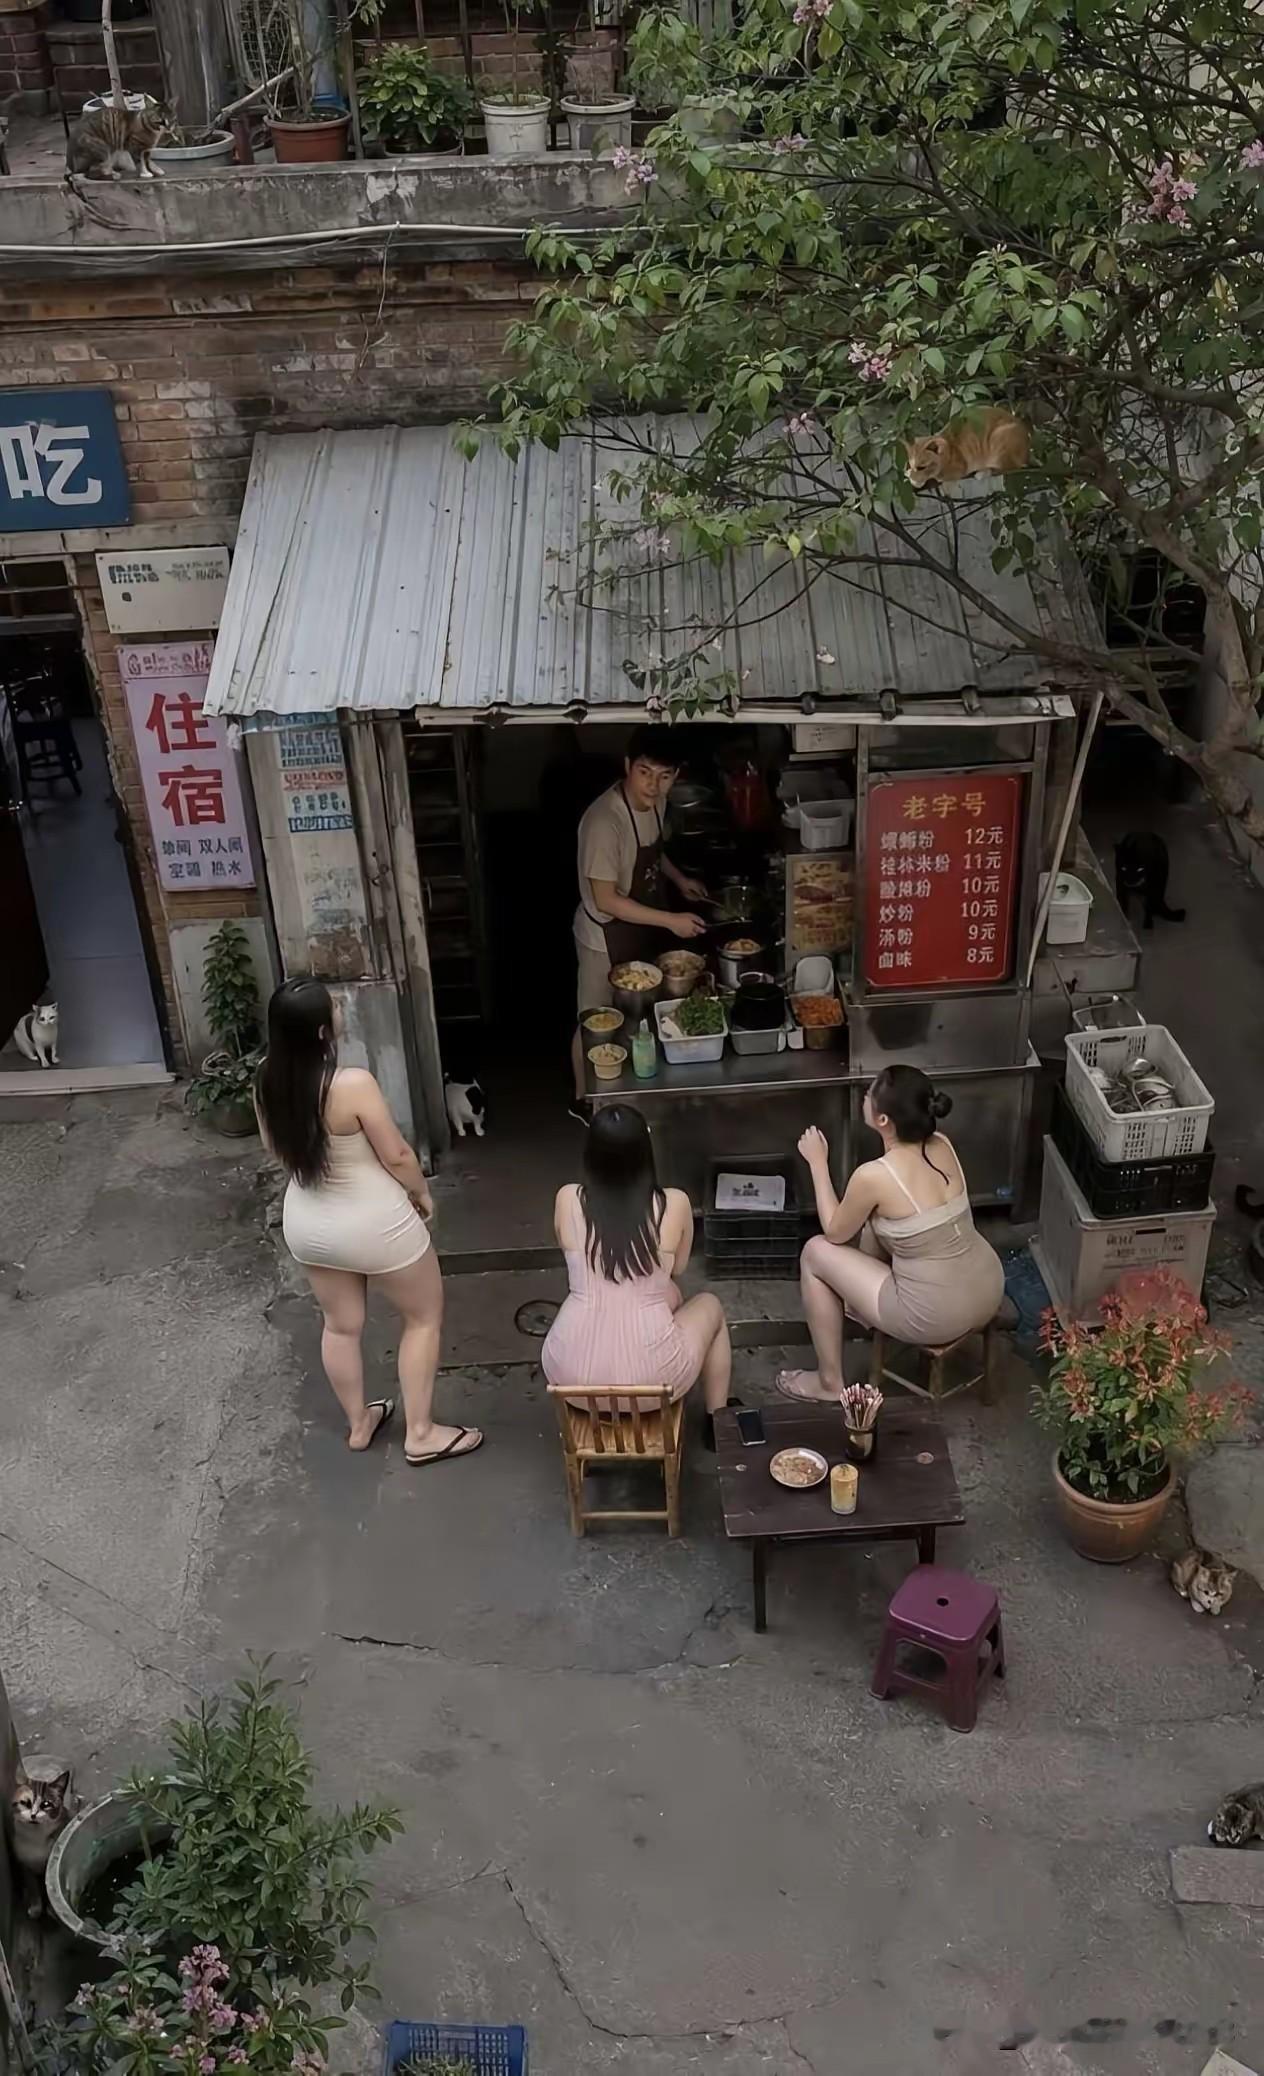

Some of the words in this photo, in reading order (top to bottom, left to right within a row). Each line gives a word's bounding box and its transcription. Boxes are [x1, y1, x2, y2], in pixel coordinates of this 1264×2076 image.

[0, 422, 102, 505] 吃
[145, 692, 226, 827] 住宿
[902, 792, 987, 820] 老字号
[966, 826, 1004, 845] 12元
[963, 851, 1001, 870] 11元
[962, 875, 1000, 894] 10元
[961, 899, 998, 918] 10元
[968, 923, 996, 941] 9元
[967, 946, 994, 964] 8元
